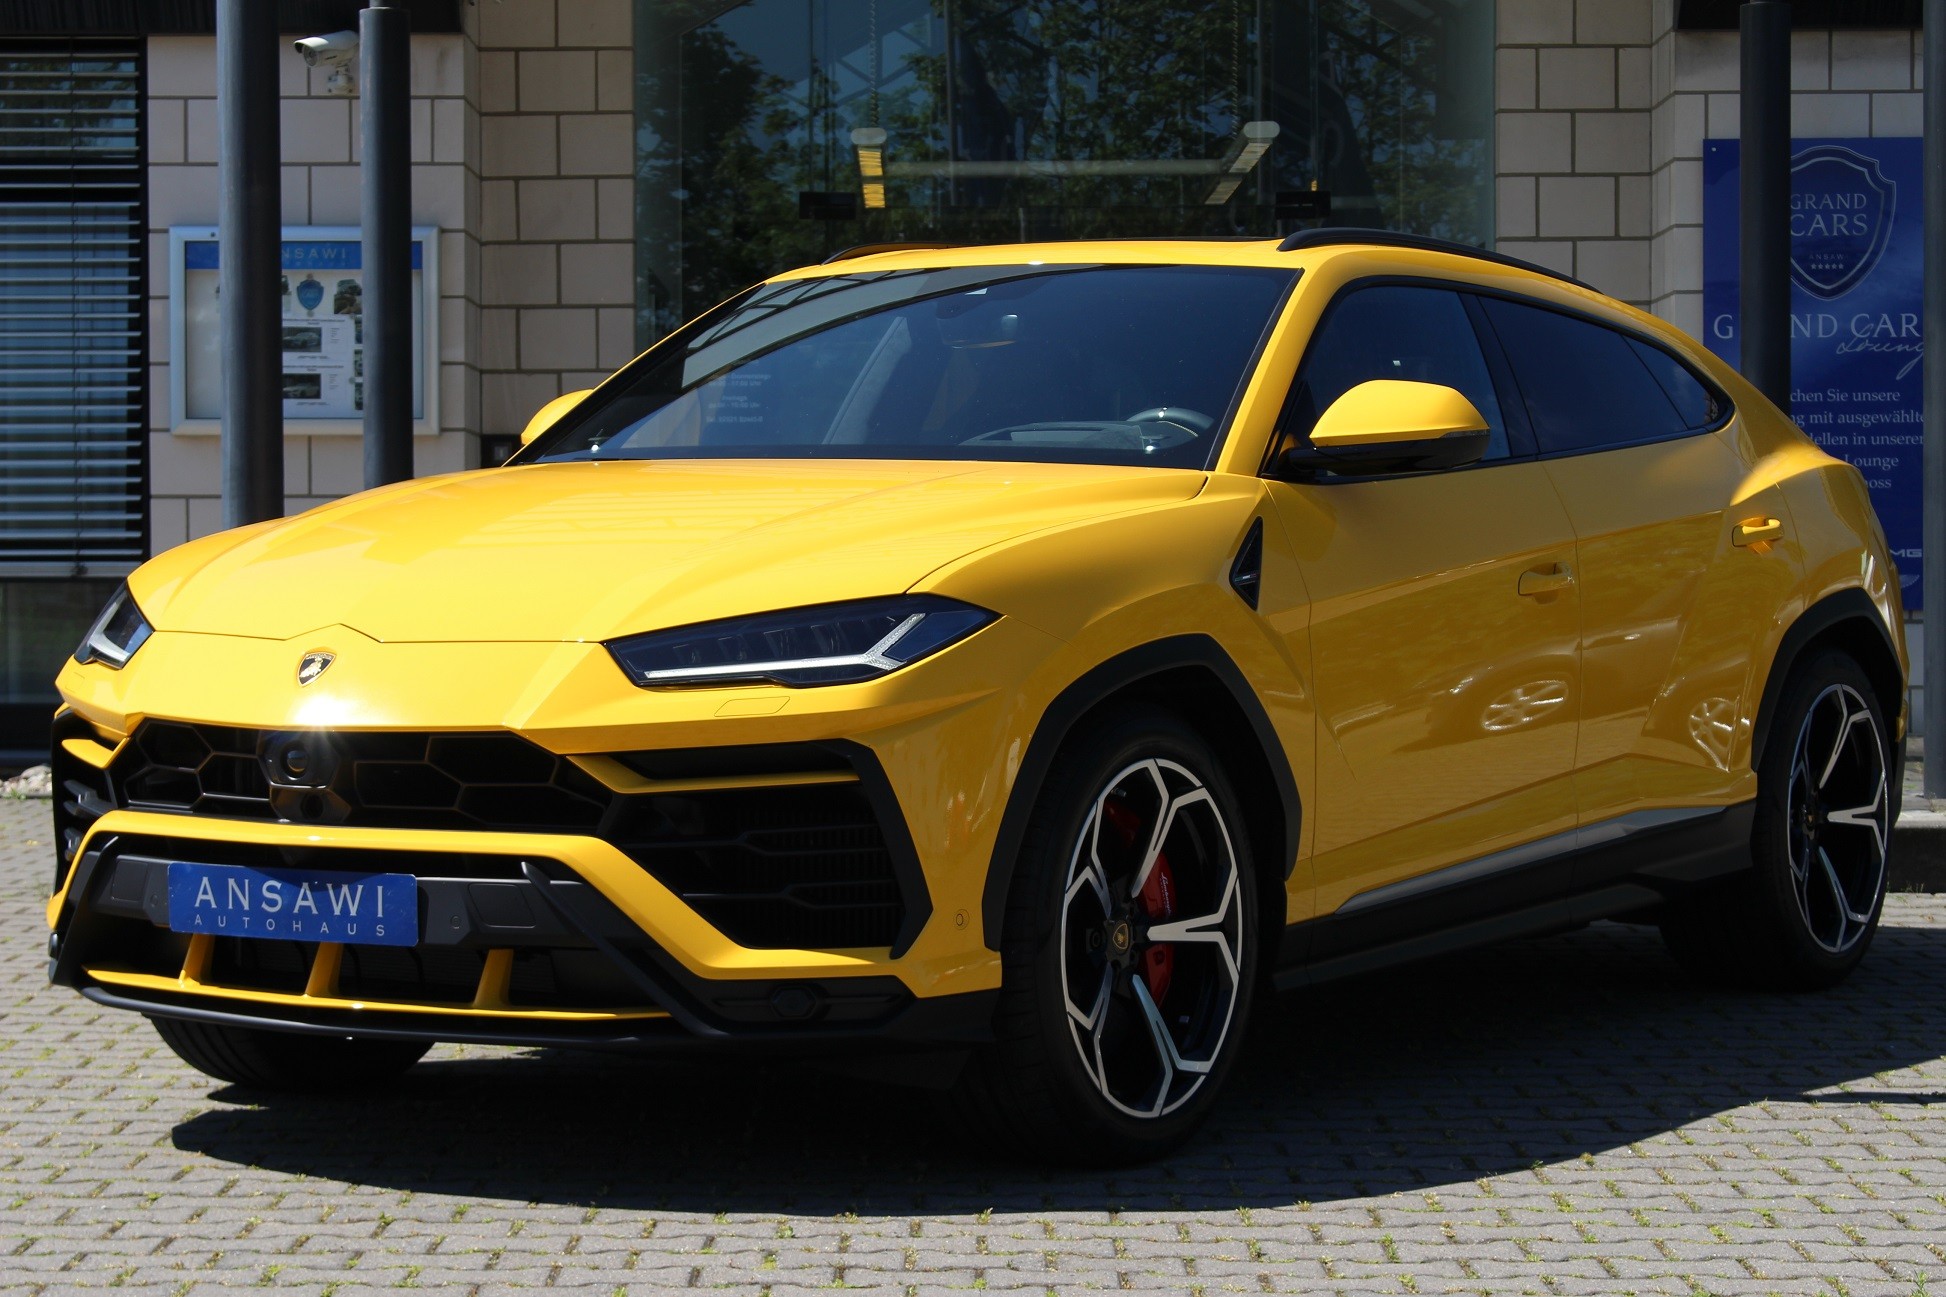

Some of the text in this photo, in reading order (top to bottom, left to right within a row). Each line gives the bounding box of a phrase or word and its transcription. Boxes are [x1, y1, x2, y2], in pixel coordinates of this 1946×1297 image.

[1790, 193, 1867, 210] GRAND
[1790, 213, 1868, 237] CARS
[281, 247, 346, 259] NSAWI
[1713, 313, 1921, 339] GND CAR
[1836, 323, 1924, 380] Loung
[1790, 388, 1901, 402] chen Sie unsere
[1809, 411, 1833, 424] mit
[1837, 409, 1924, 428] ausgewählt
[1810, 432, 1848, 446] ellen
[1853, 432, 1867, 446] in
[194, 876, 384, 918] ANSAWI
[194, 914, 385, 937] AUTOHAUS
